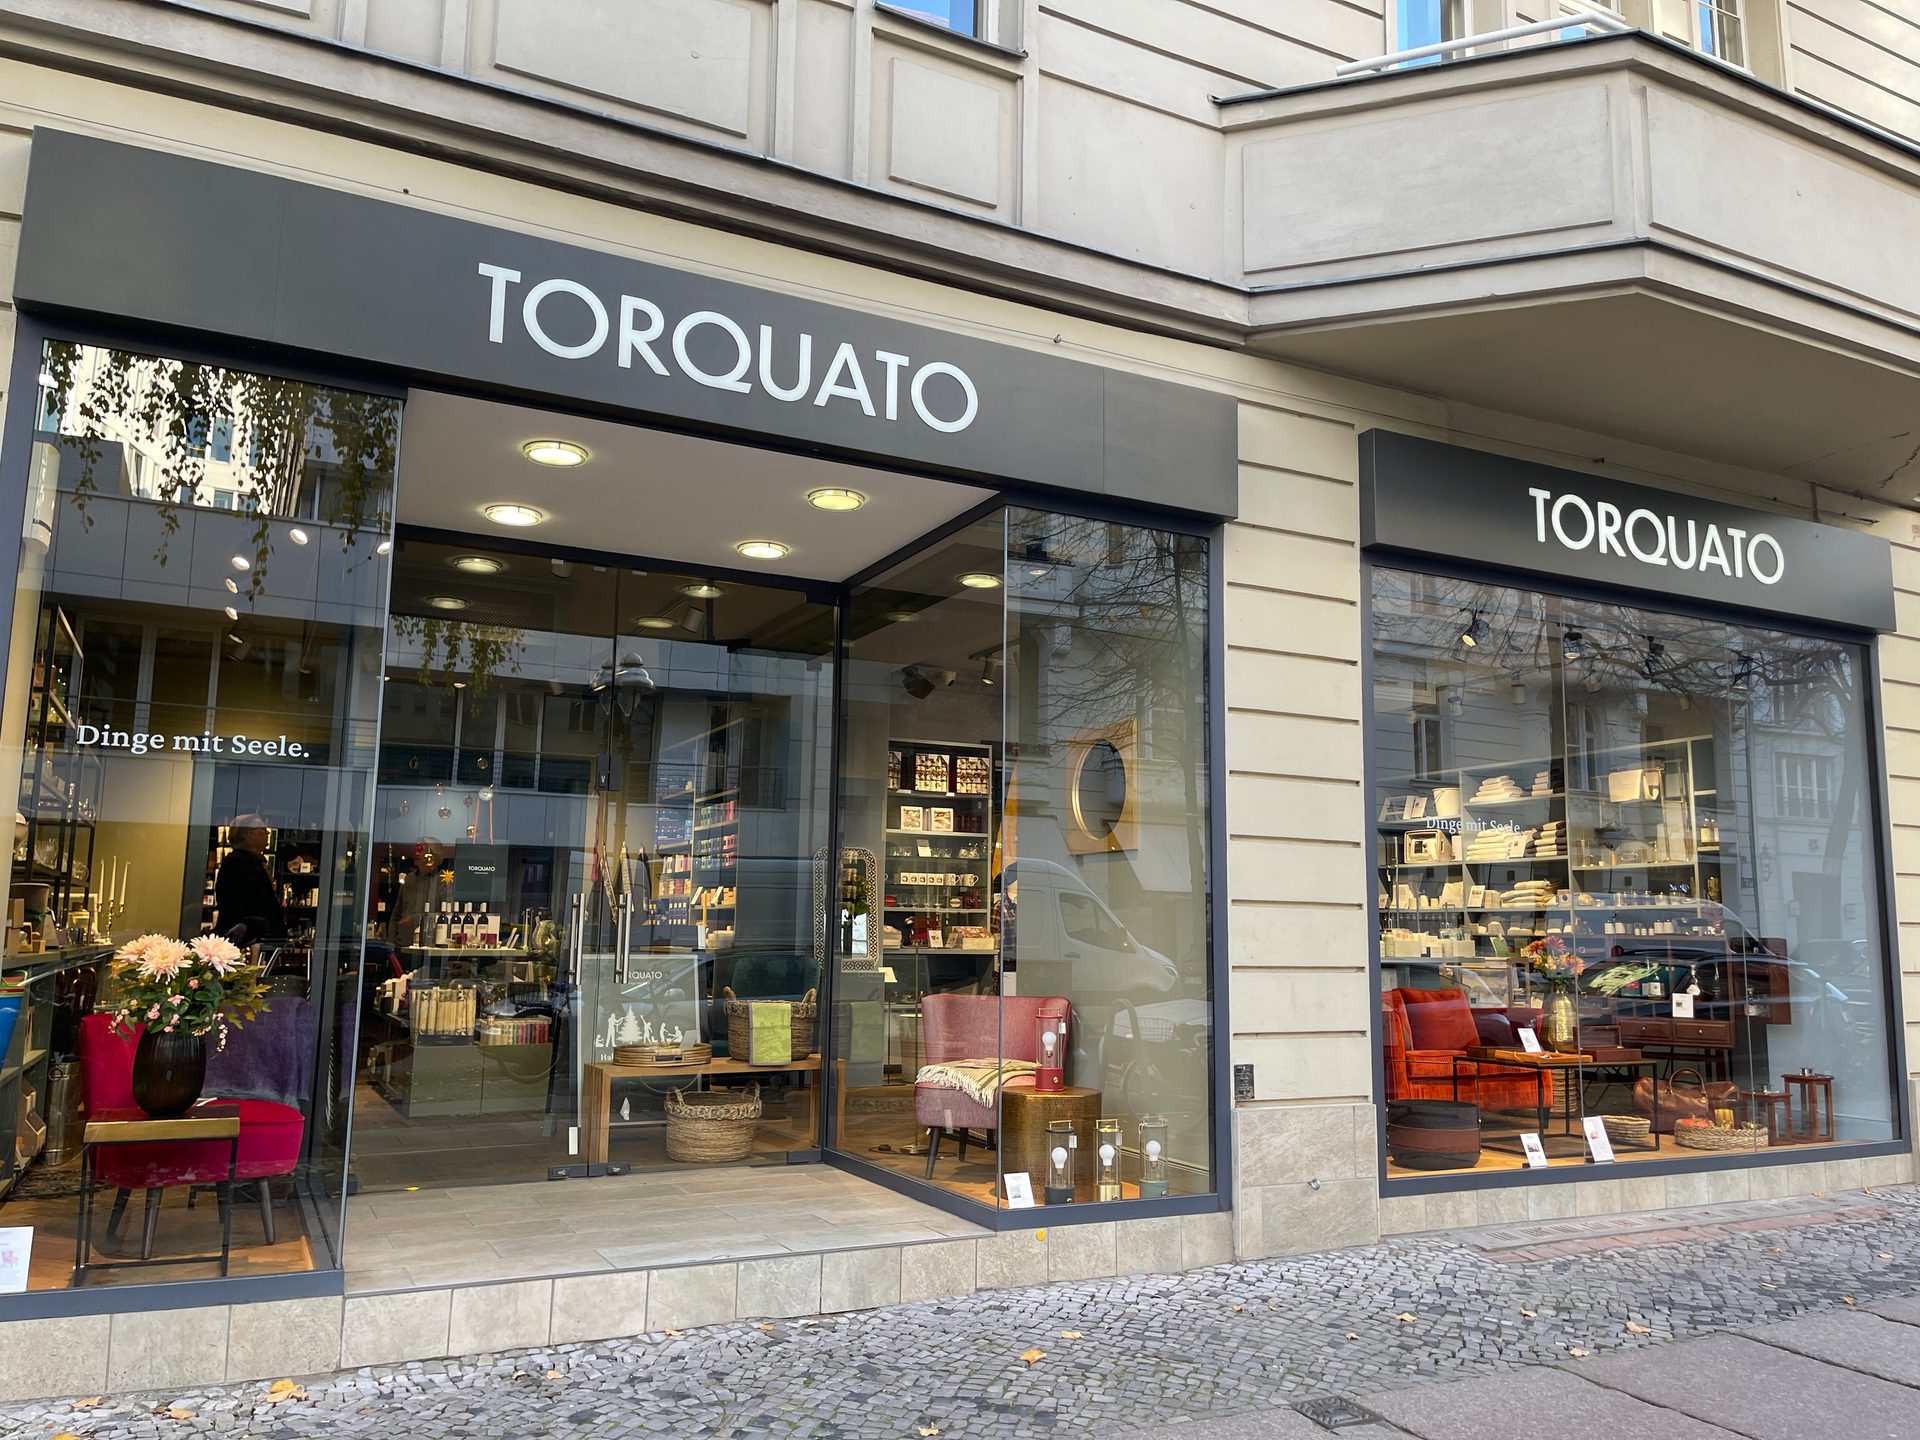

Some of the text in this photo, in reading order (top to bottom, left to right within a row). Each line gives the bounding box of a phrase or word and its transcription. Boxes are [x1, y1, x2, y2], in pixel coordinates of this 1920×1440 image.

[478, 262, 979, 433] TORQUATO
[1528, 487, 1785, 585] TORQUATO
[76, 724, 310, 758] Dinge mit Seele.
[1426, 816, 1462, 834] Dinge
[1466, 818, 1487, 832] mit
